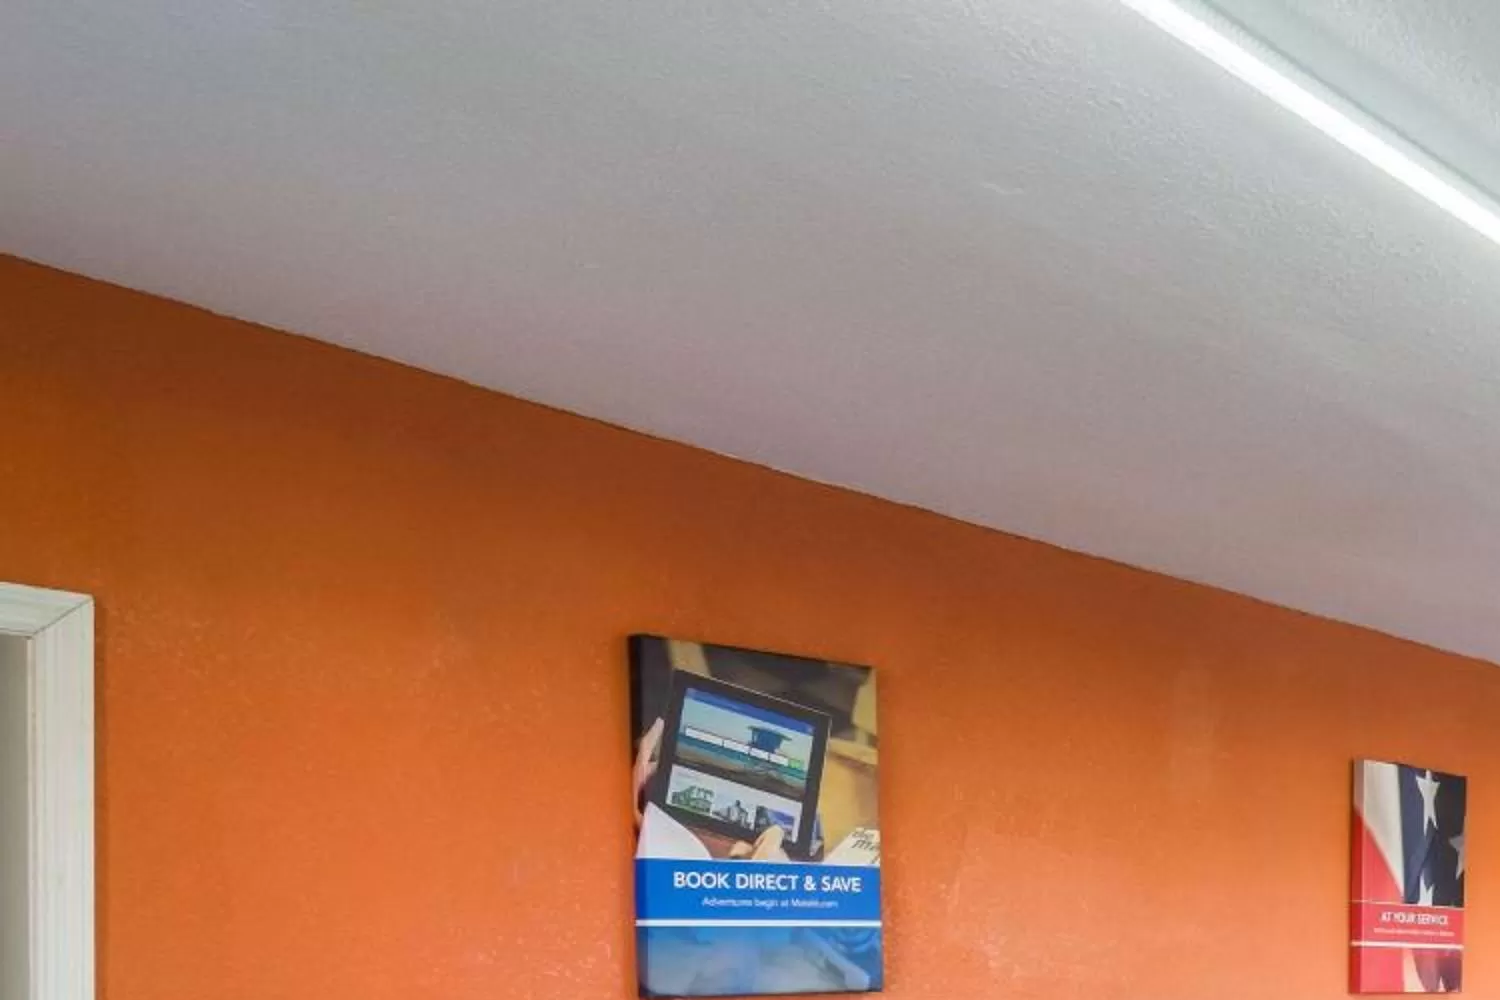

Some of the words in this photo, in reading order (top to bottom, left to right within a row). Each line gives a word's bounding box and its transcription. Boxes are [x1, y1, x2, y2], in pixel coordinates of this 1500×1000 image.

[673, 871, 730, 889] BOOK
[735, 873, 799, 891] DIRECT
[803, 875, 816, 891] &
[821, 876, 862, 893] SAVE
[1394, 911, 1416, 924] YOUR
